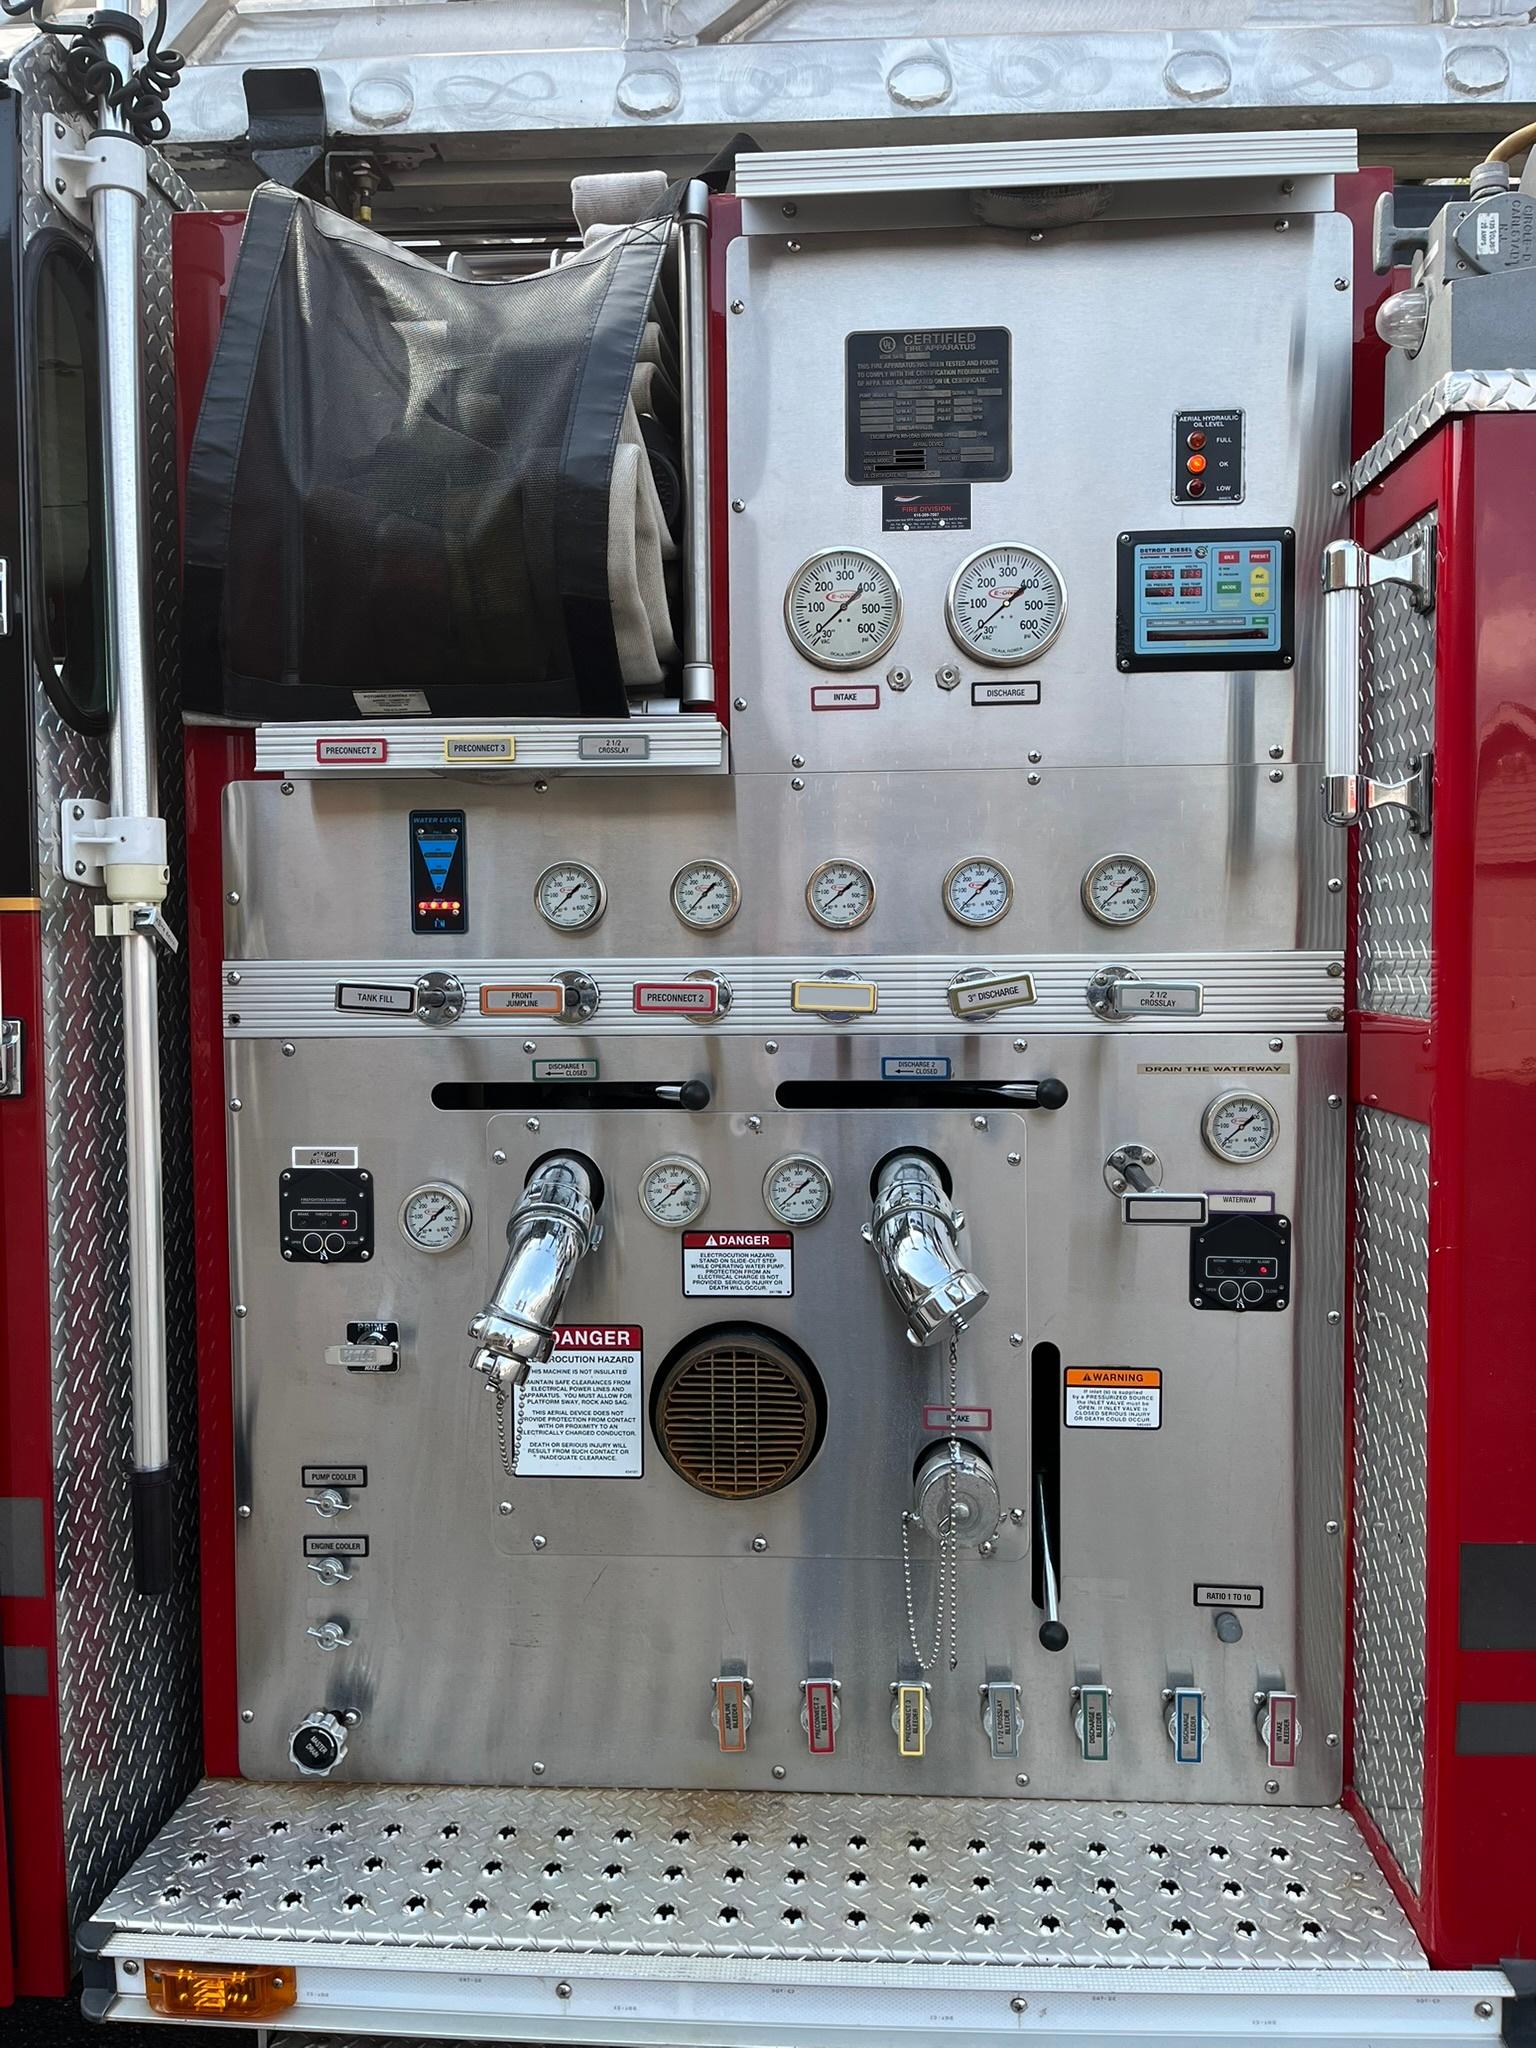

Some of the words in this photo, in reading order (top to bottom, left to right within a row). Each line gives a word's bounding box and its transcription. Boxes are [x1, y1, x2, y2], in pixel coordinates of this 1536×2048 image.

[904, 333, 976, 345] CERTIFIED
[836, 570, 854, 580] 300
[999, 567, 1017, 577] 300
[815, 582, 833, 592] 200
[858, 582, 876, 592] 400
[978, 578, 996, 588] 200
[1020, 579, 1039, 589] 400
[808, 602, 825, 612] 100
[862, 603, 880, 614] 500
[970, 599, 987, 609] 100
[1024, 600, 1043, 610] 500
[857, 623, 876, 634] 600
[1020, 620, 1038, 630] 600
[833, 693, 857, 701] INTAKE
[987, 689, 1025, 698] DISCHARGE
[454, 744, 499, 752] PRECONNECT
[500, 744, 506, 752] 3
[598, 746, 629, 754] CROSSLAY
[358, 993, 377, 1002] TANK
[379, 994, 394, 1003] FILL
[647, 993, 697, 1002] PRECONNECT
[978, 986, 1019, 1001] DISCHARGE
[1140, 999, 1176, 1007] CROSSLAY
[719, 1235, 770, 1245] DANGER
[358, 1323, 388, 1332] PRIME
[1093, 1374, 1144, 1382] WARNING
[1206, 1592, 1226, 1600] RATIO
[310, 1736, 328, 1754] MASTER
